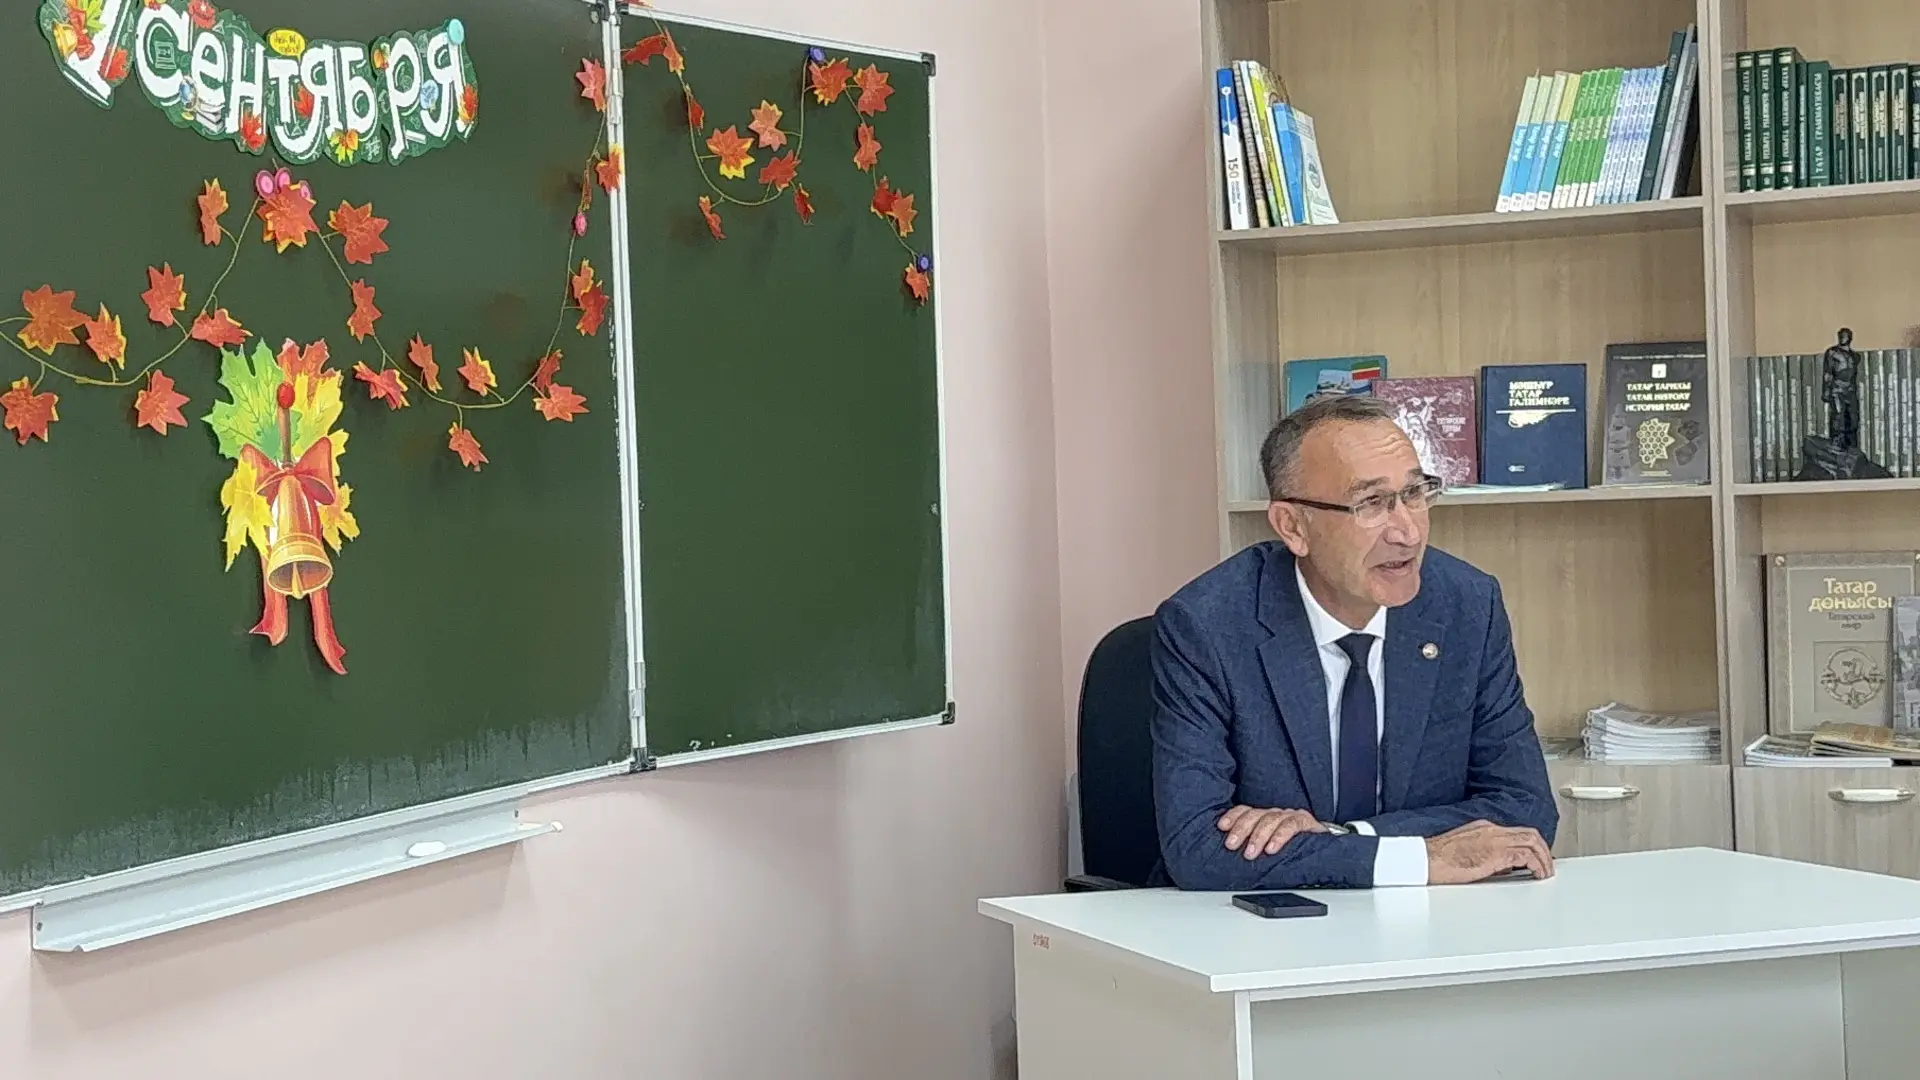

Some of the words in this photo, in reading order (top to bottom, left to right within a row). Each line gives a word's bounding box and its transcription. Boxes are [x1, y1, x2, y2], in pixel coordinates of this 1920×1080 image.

[1227, 157, 1239, 179] 150
[1815, 146, 1824, 173] ТАТАР
[1509, 389, 1543, 398] ТАТАР
[1627, 383, 1653, 391] ТАТАР
[1823, 577, 1877, 597] Татар
[1808, 596, 1893, 612] дөньясы
